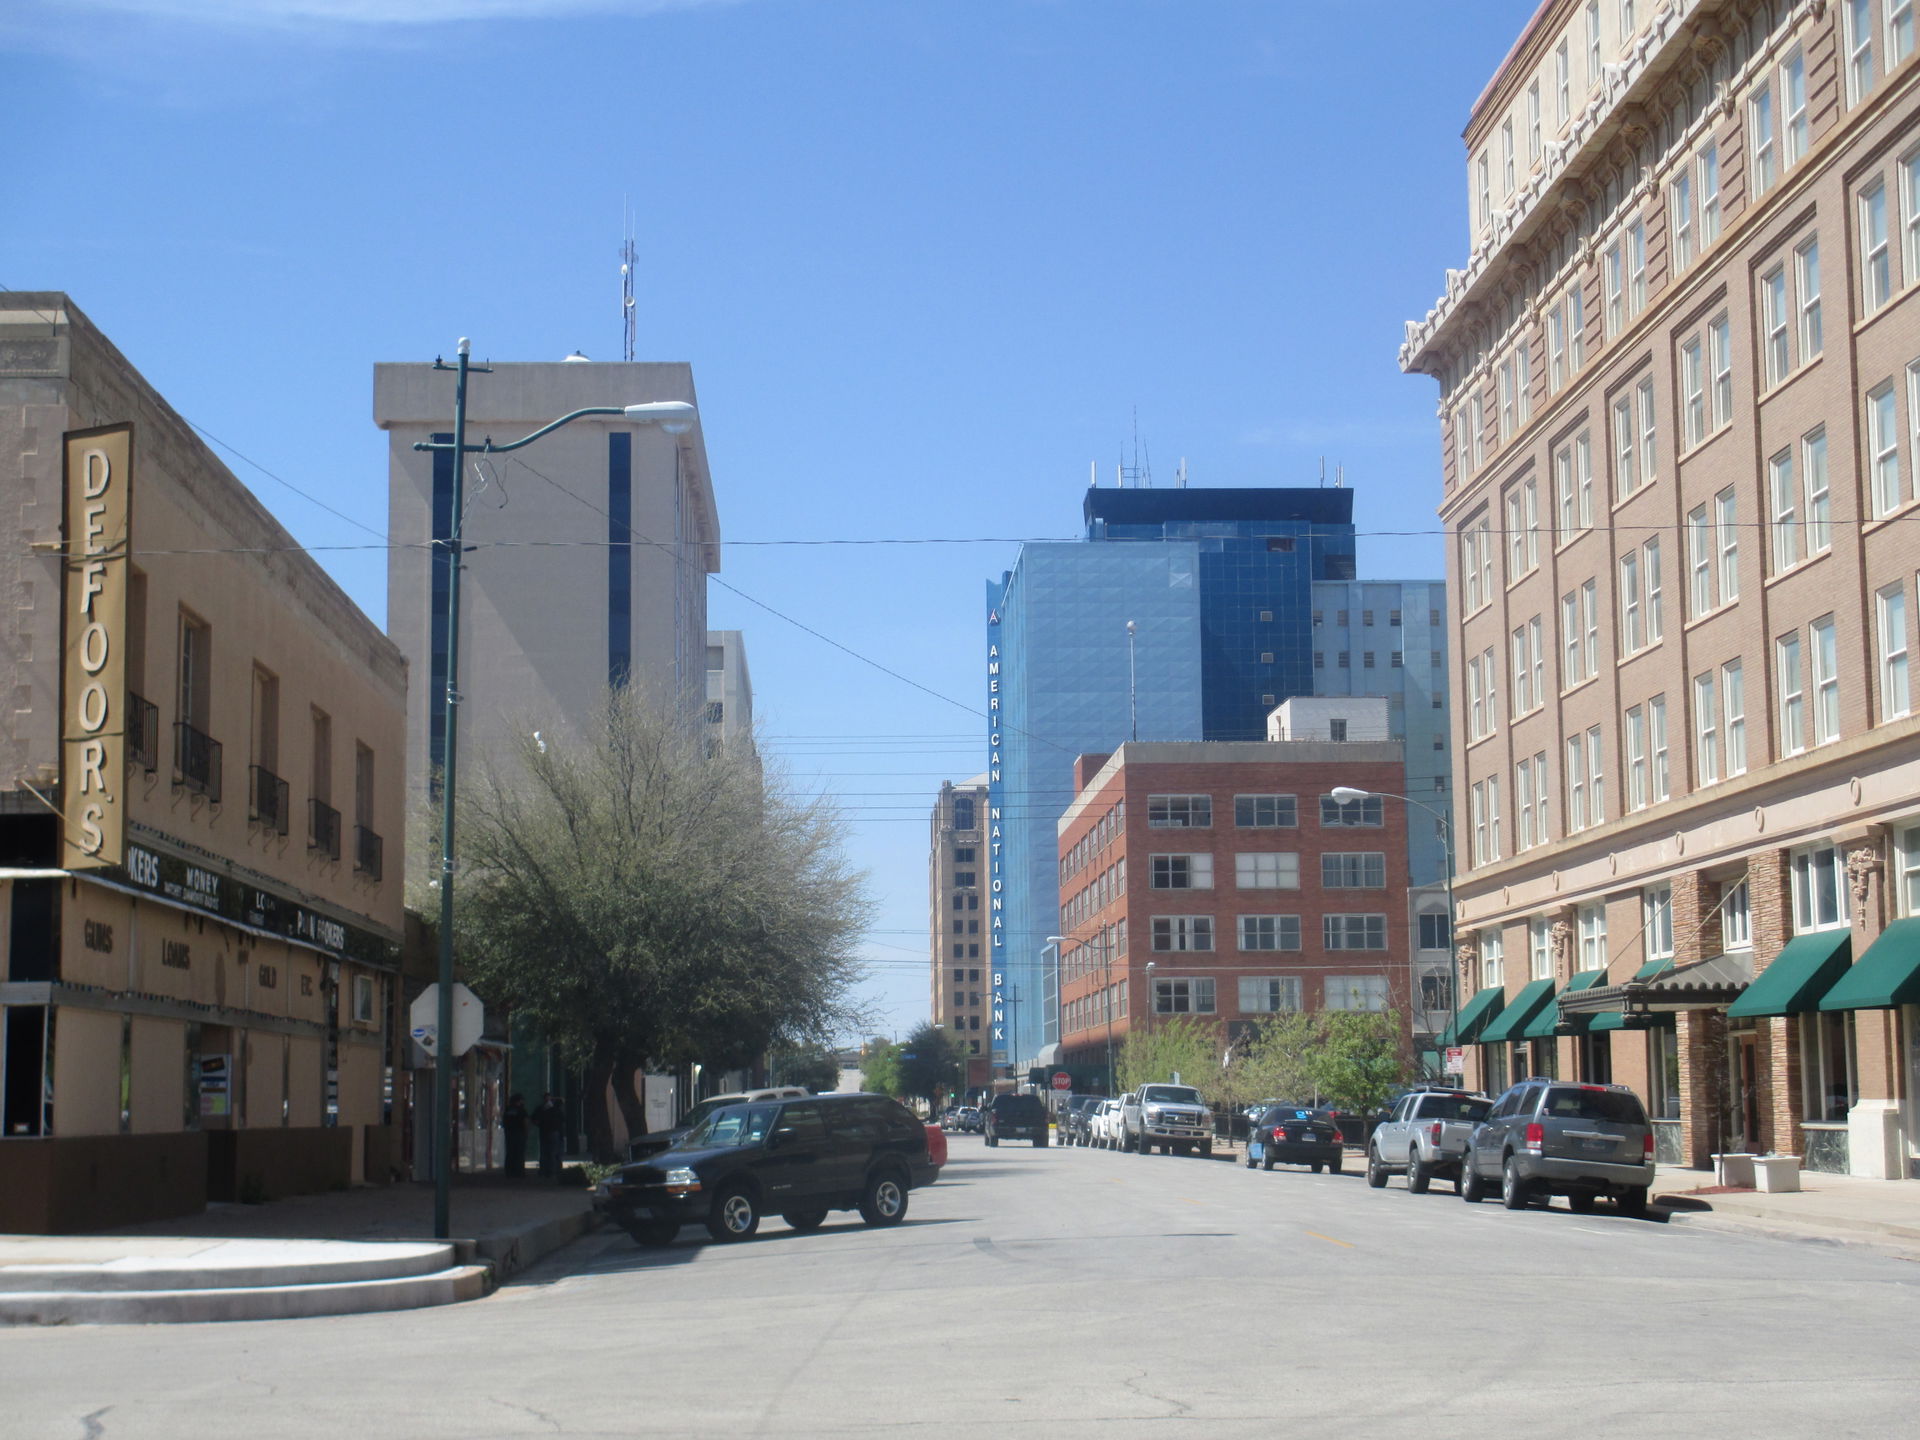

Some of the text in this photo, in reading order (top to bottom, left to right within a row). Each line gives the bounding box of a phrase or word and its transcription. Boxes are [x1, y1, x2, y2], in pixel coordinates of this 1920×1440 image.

[79, 448, 114, 856] DEFOOR'S
[989, 645, 1003, 1040] AMERICAN NATIONAL BANK
[128, 846, 158, 888] KERS
[185, 867, 218, 895] MONEY
[1052, 1077, 1069, 1085] STOP
